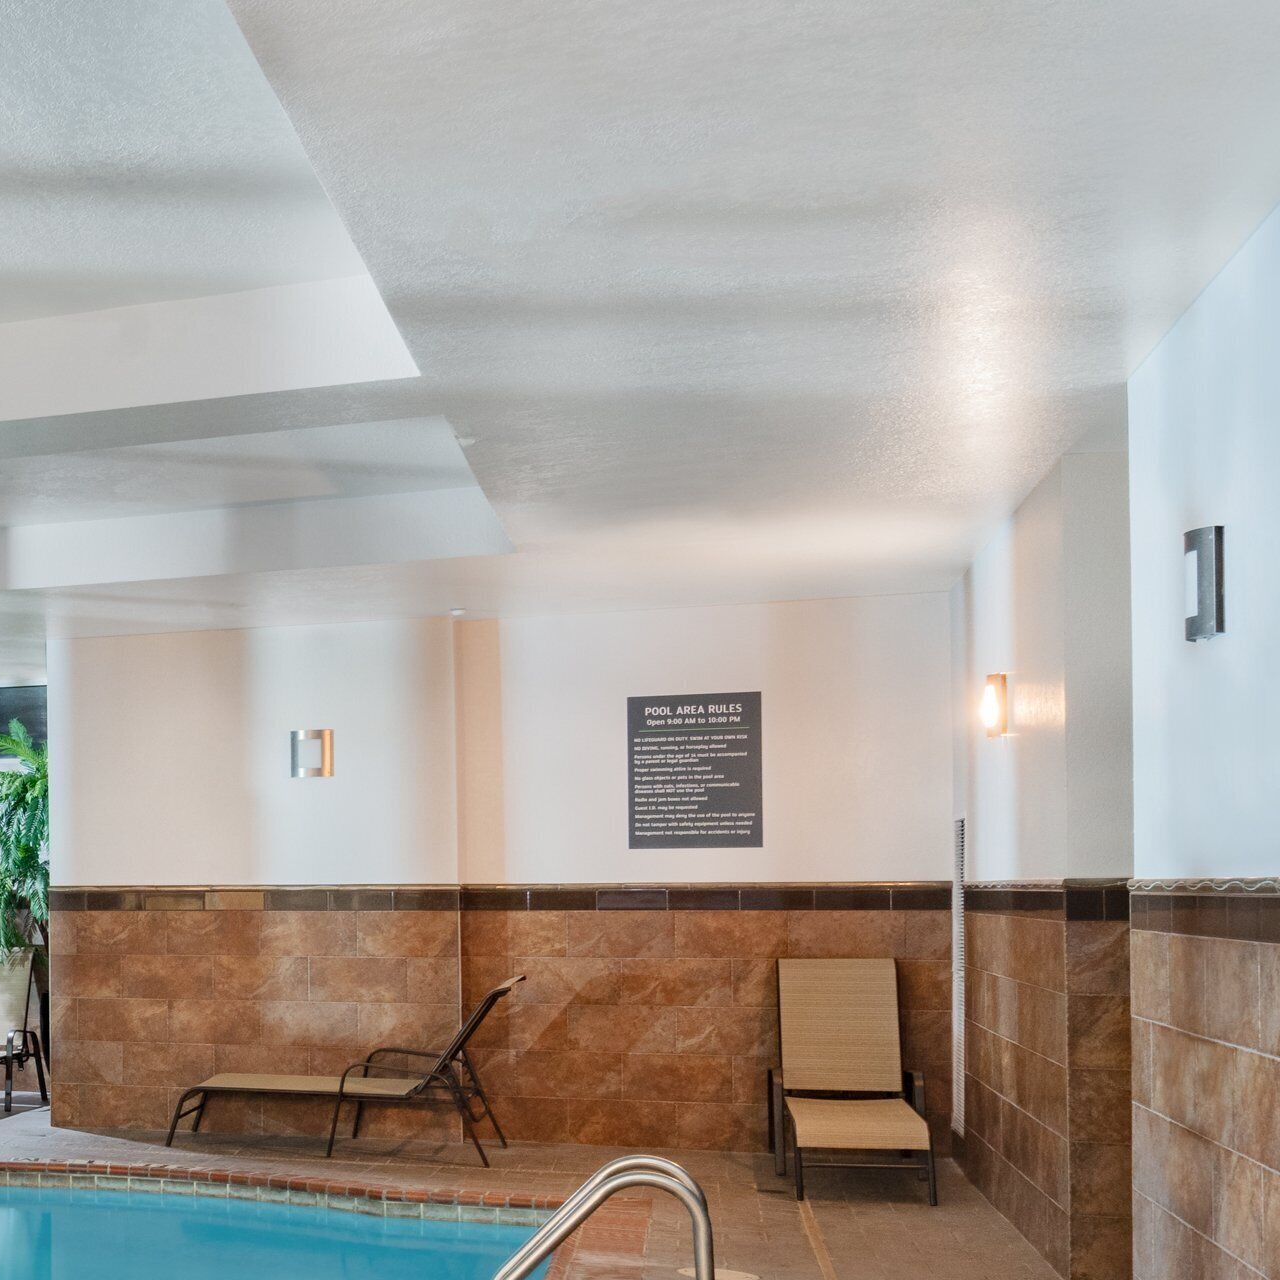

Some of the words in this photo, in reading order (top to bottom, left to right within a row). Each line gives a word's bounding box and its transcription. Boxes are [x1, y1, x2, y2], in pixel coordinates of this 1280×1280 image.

[645, 707, 672, 716] POOL
[676, 706, 704, 714] AREA
[708, 704, 742, 713] RULES
